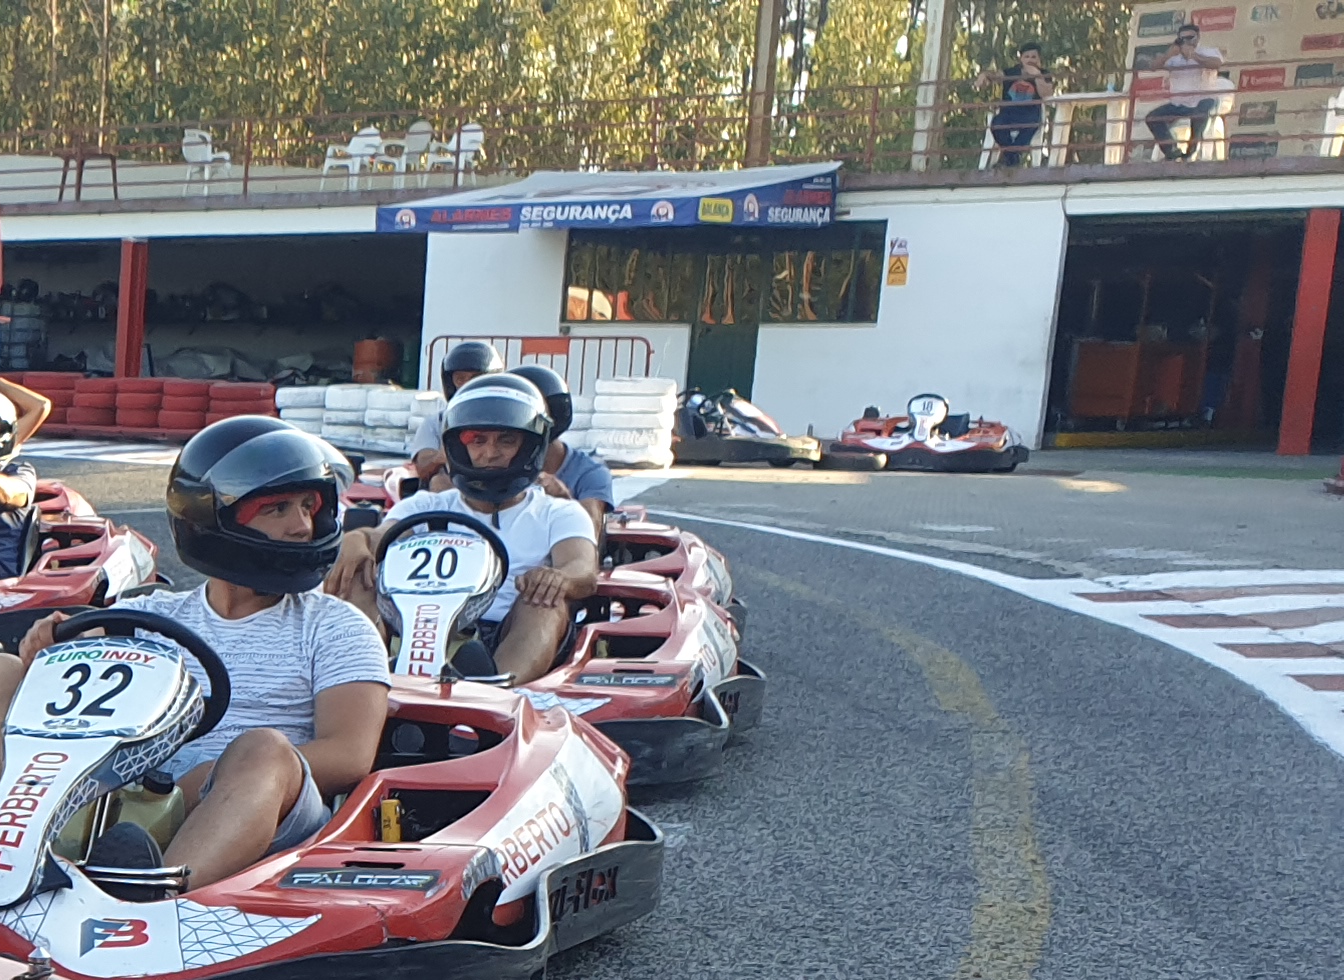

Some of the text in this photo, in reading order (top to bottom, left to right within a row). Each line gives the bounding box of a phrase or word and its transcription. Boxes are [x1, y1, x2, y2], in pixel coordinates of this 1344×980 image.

[519, 203, 633, 223] SEGURANÇA
[767, 207, 831, 227] SEGURANÇA
[398, 538, 473, 551] EUROINDY
[406, 546, 459, 580] 20
[408, 603, 441, 678] FERBERTO
[44, 649, 157, 667] EUROINDY
[45, 663, 134, 717] 32
[581, 675, 675, 685] PALOCAR
[493, 801, 571, 888] RBERTO
[291, 872, 434, 888] PALOCAR
